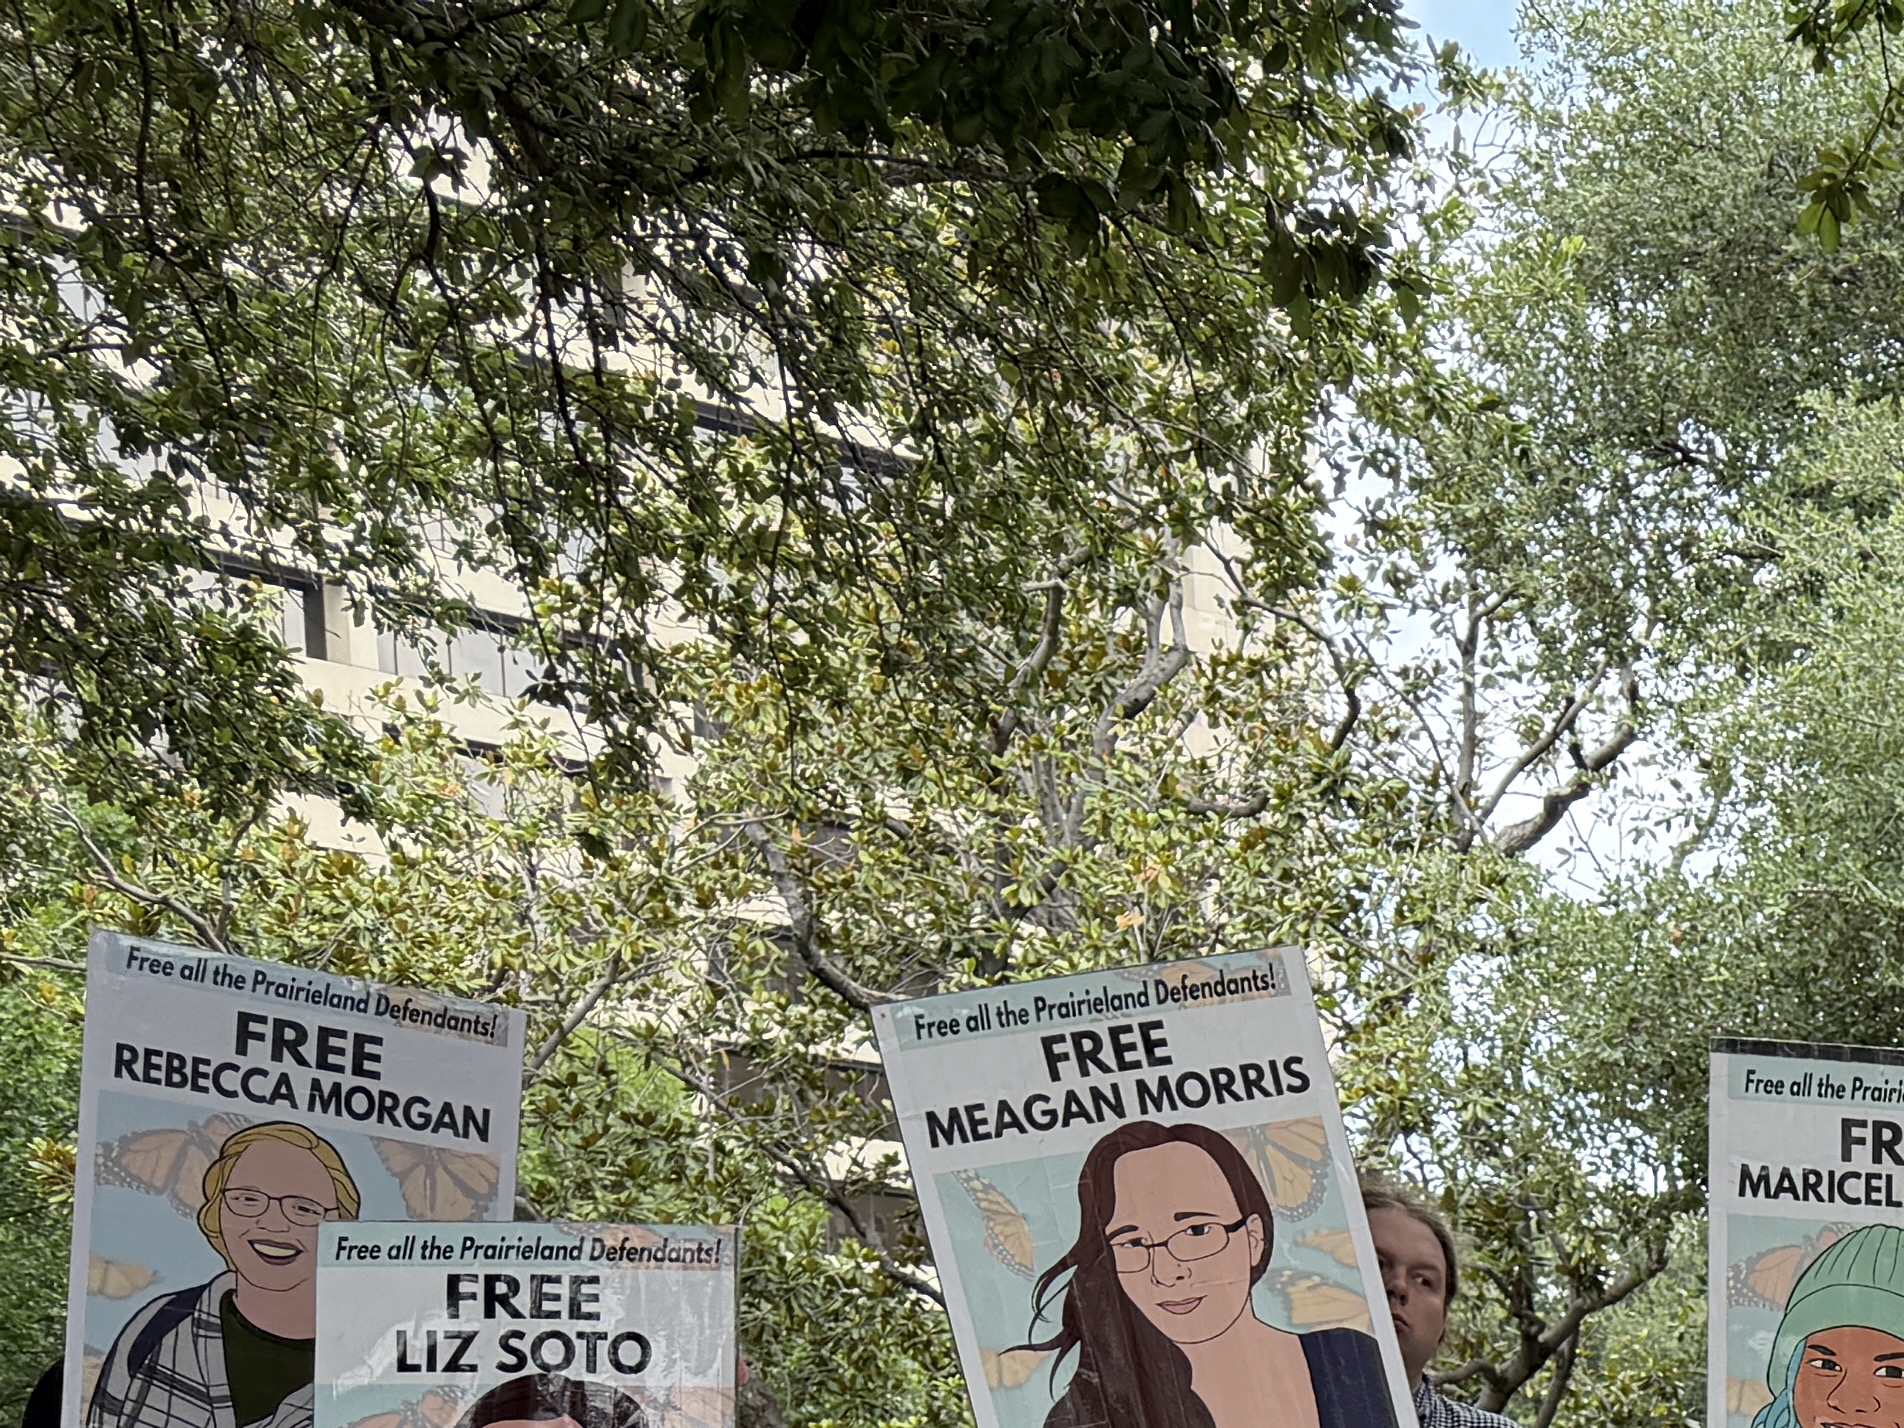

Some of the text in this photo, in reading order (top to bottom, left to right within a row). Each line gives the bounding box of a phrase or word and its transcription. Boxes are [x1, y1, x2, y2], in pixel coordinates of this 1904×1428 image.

[126, 946, 496, 1038] Free all the Prairieland Defendants!
[913, 965, 1276, 1040] Free all the Prairieland Defendants!
[235, 1011, 383, 1080] FREE
[1041, 1020, 1174, 1082] FREE
[114, 1043, 490, 1143] REBECCA MORGAN
[925, 1056, 1311, 1148] MEAGAN MORRIS
[1745, 1069, 1784, 1096] Free
[1790, 1074, 1813, 1098] all
[1817, 1076, 1845, 1100] the
[335, 1236, 720, 1264] Free all the Prairieland Defendants!
[446, 1274, 600, 1320] FREE
[396, 1330, 651, 1375] LIZ SOTO
